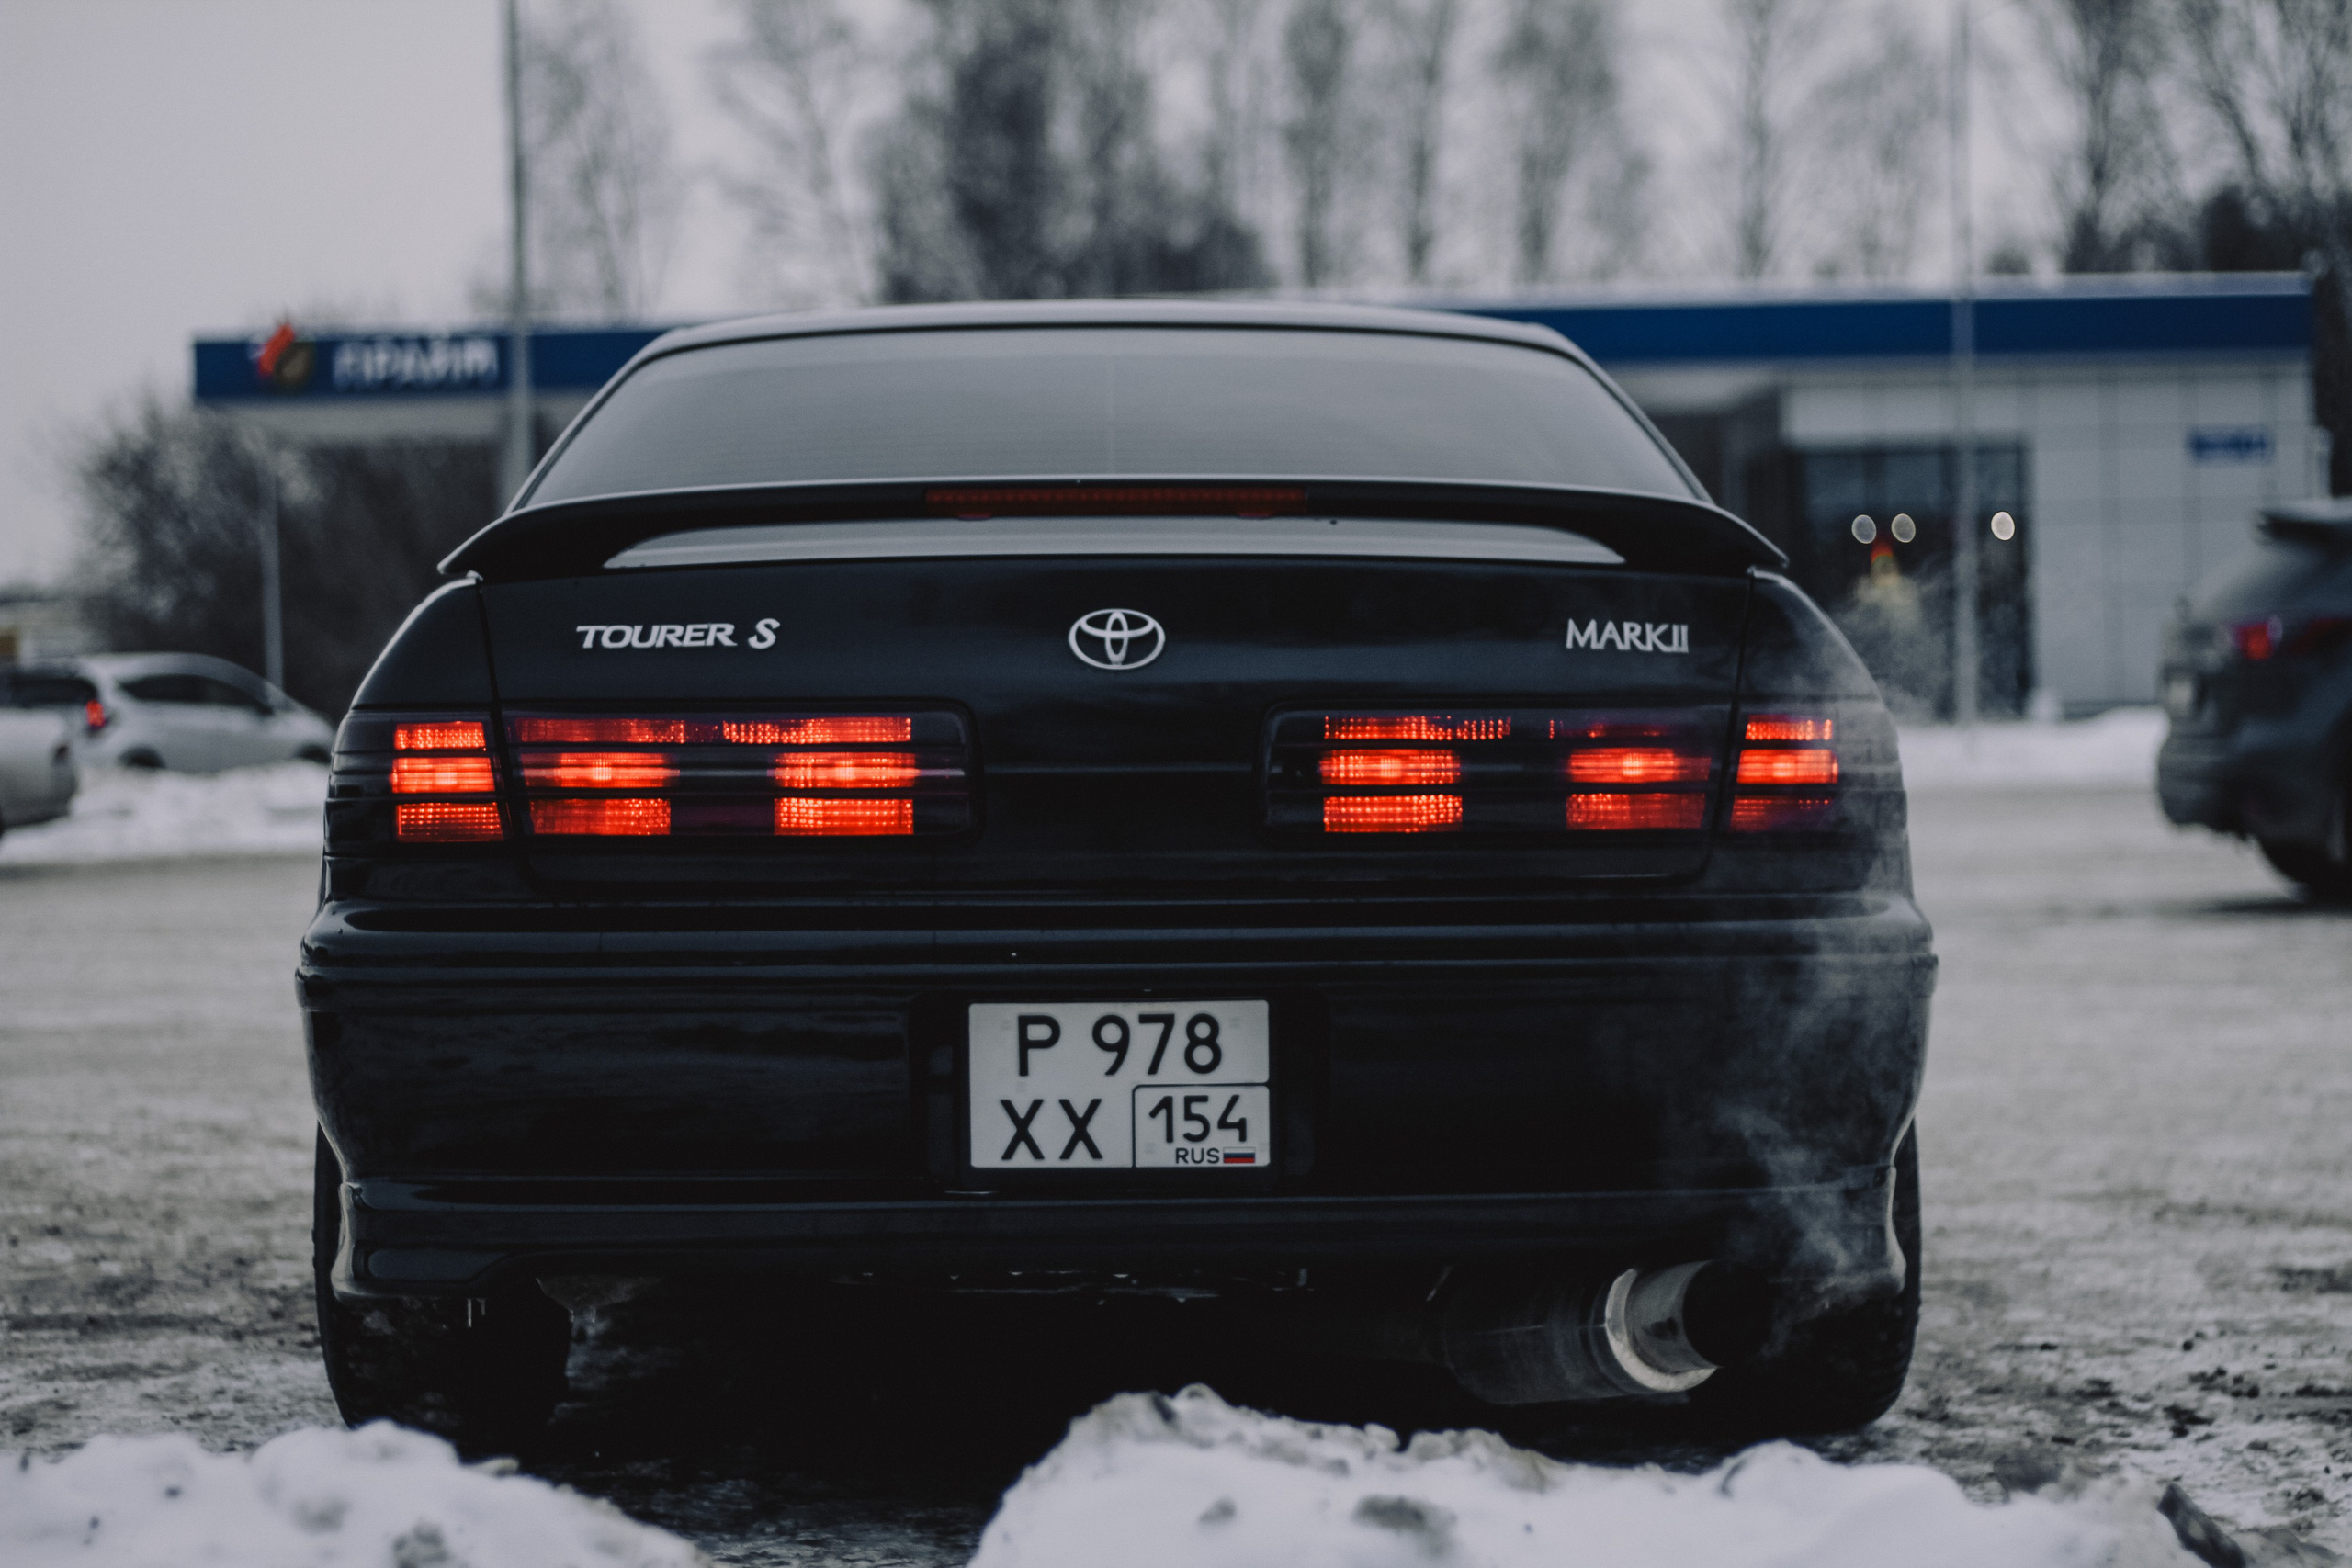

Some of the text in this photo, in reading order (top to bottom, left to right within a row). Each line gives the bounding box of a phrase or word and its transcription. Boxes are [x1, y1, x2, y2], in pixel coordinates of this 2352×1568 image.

[576, 618, 780, 649] TOURER S
[1018, 1013, 1222, 1077] P 978
[1000, 1098, 1103, 1160] XX
[1148, 1094, 1247, 1144] 154
[1175, 1147, 1220, 1165] RUS
